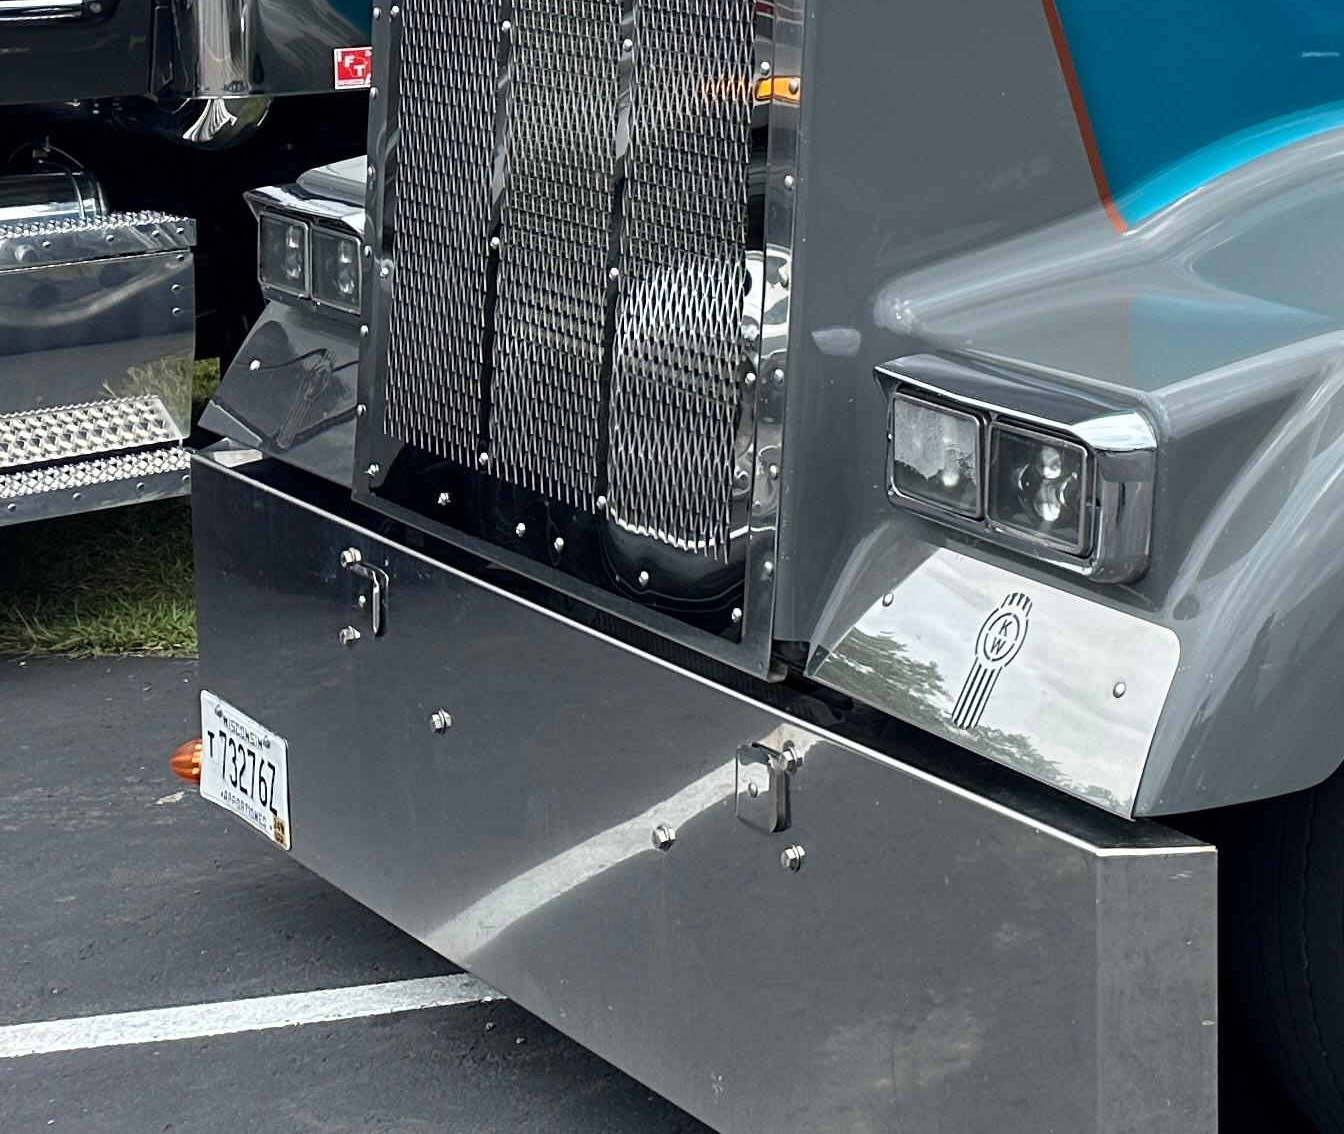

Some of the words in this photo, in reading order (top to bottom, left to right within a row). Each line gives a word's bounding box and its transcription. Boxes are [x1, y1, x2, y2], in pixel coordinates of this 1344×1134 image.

[223, 716, 263, 750] WISCONSIN
[207, 730, 215, 758] T
[219, 730, 278, 816] 73276Z
